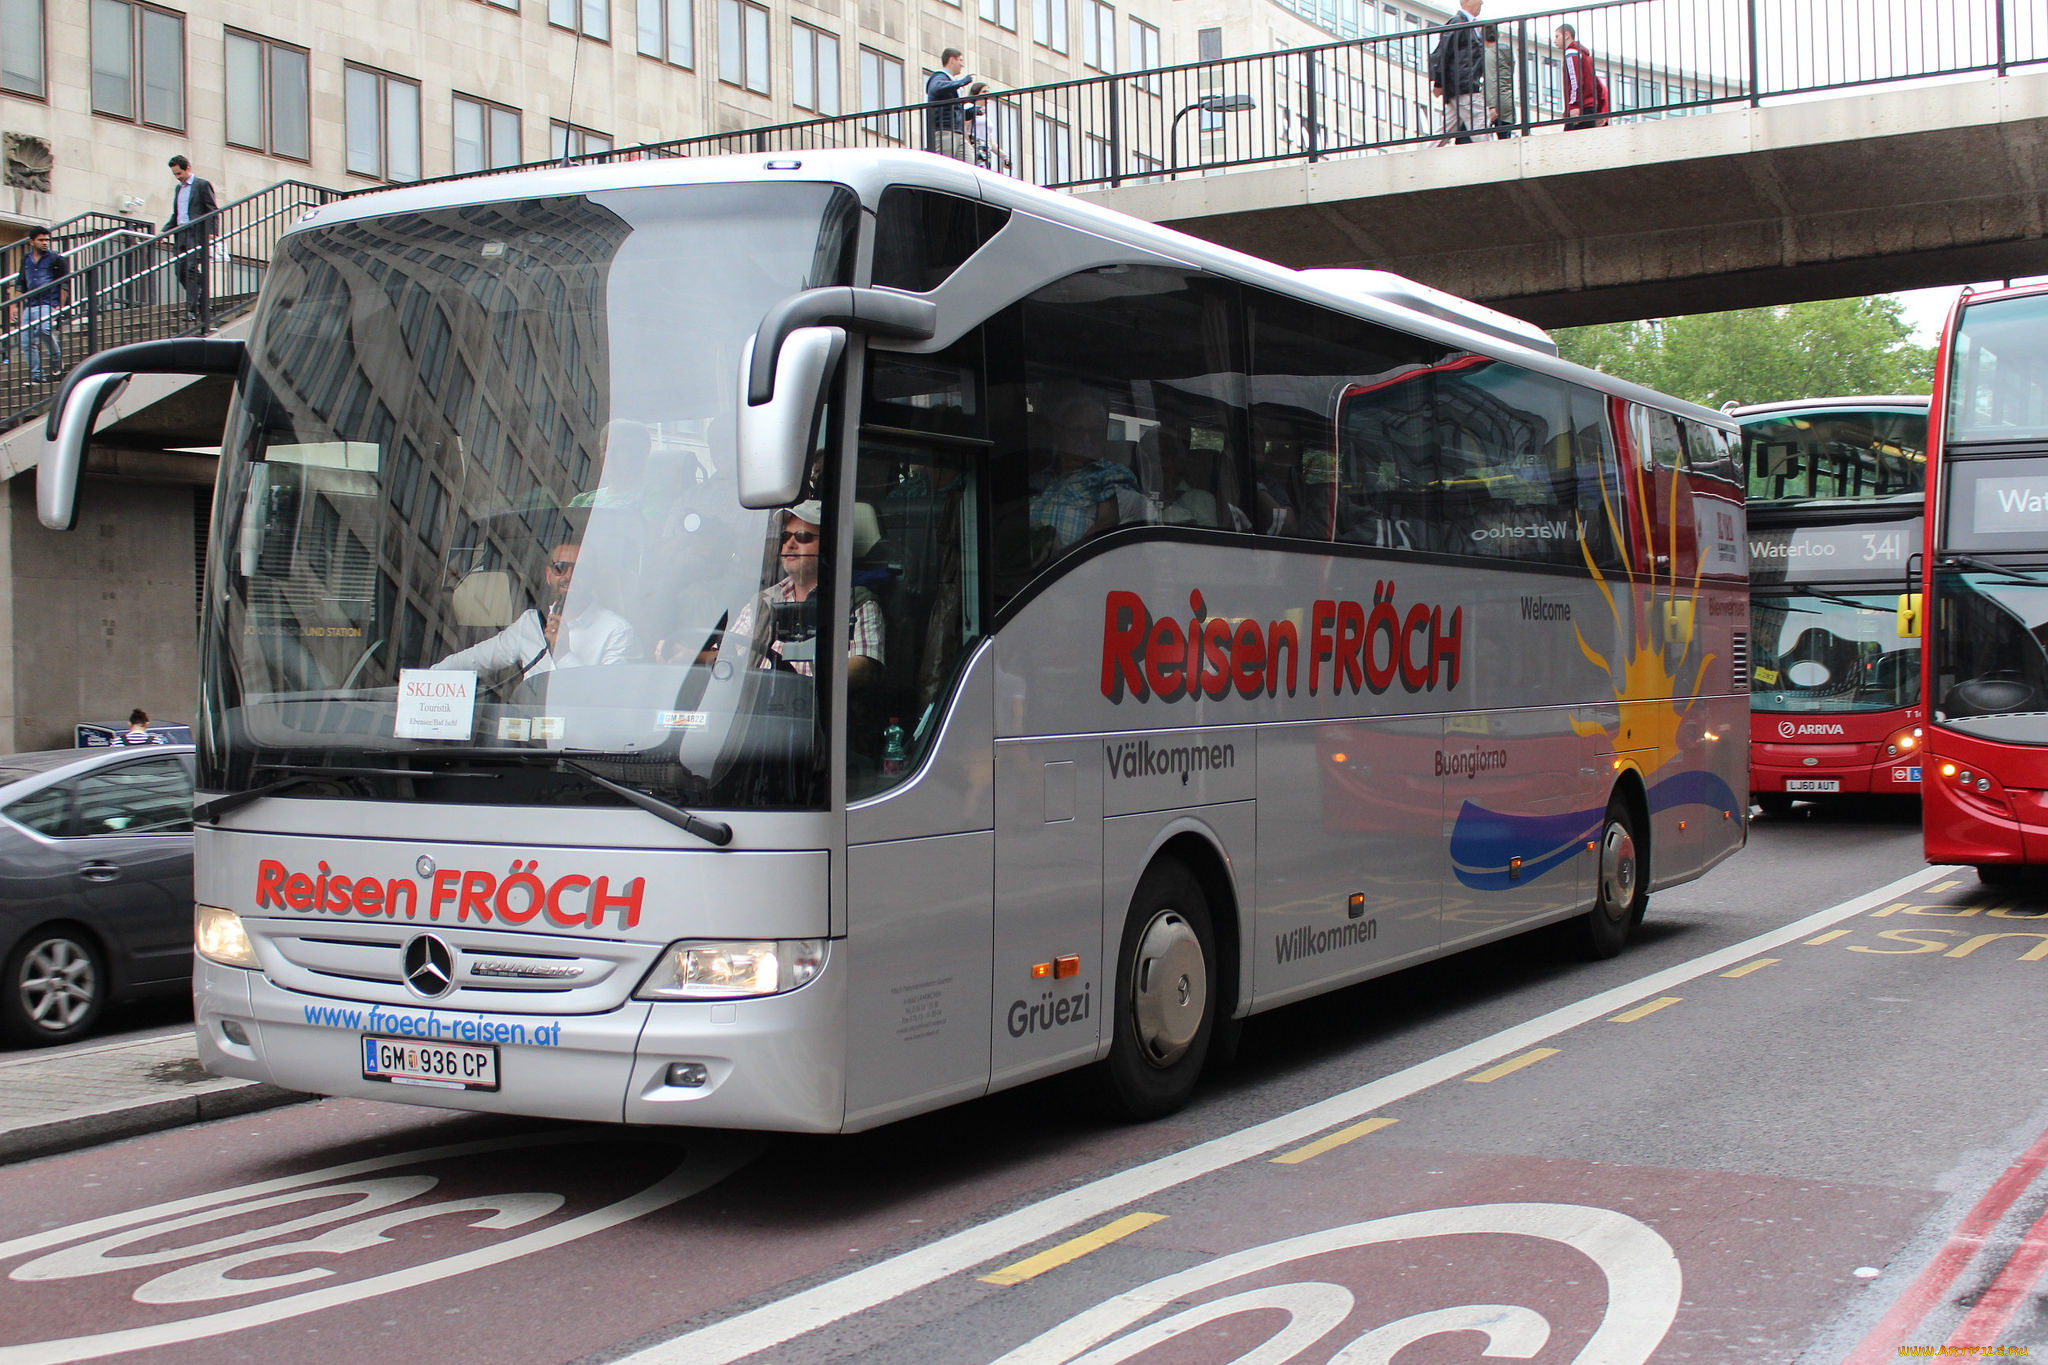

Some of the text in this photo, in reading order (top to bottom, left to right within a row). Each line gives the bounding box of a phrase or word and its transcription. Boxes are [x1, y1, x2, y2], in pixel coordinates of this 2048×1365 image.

[1749, 533, 1901, 562] Waterloo 341
[1520, 596, 1572, 622] Welcome
[1708, 597, 1746, 617] Bienvenue
[326, 627, 362, 638] STATION
[1100, 580, 1464, 702] Reisen FRÖCH
[406, 681, 467, 698] SKLONA
[418, 702, 452, 713] Touristik
[1797, 723, 1845, 736] ARRIVA
[1106, 739, 1235, 780] Välkommen
[1435, 744, 1507, 779] Buongiorno
[1790, 781, 1836, 790] LJ60 AUT
[256, 858, 648, 929] Reisen FRÖCH
[1275, 917, 1378, 965] Willkommen
[303, 1004, 562, 1047] www.froech-reisen.at
[1008, 982, 1090, 1038] Grüezi
[380, 1045, 406, 1071] GM
[420, 1049, 458, 1076] 936
[463, 1052, 489, 1078] CP
